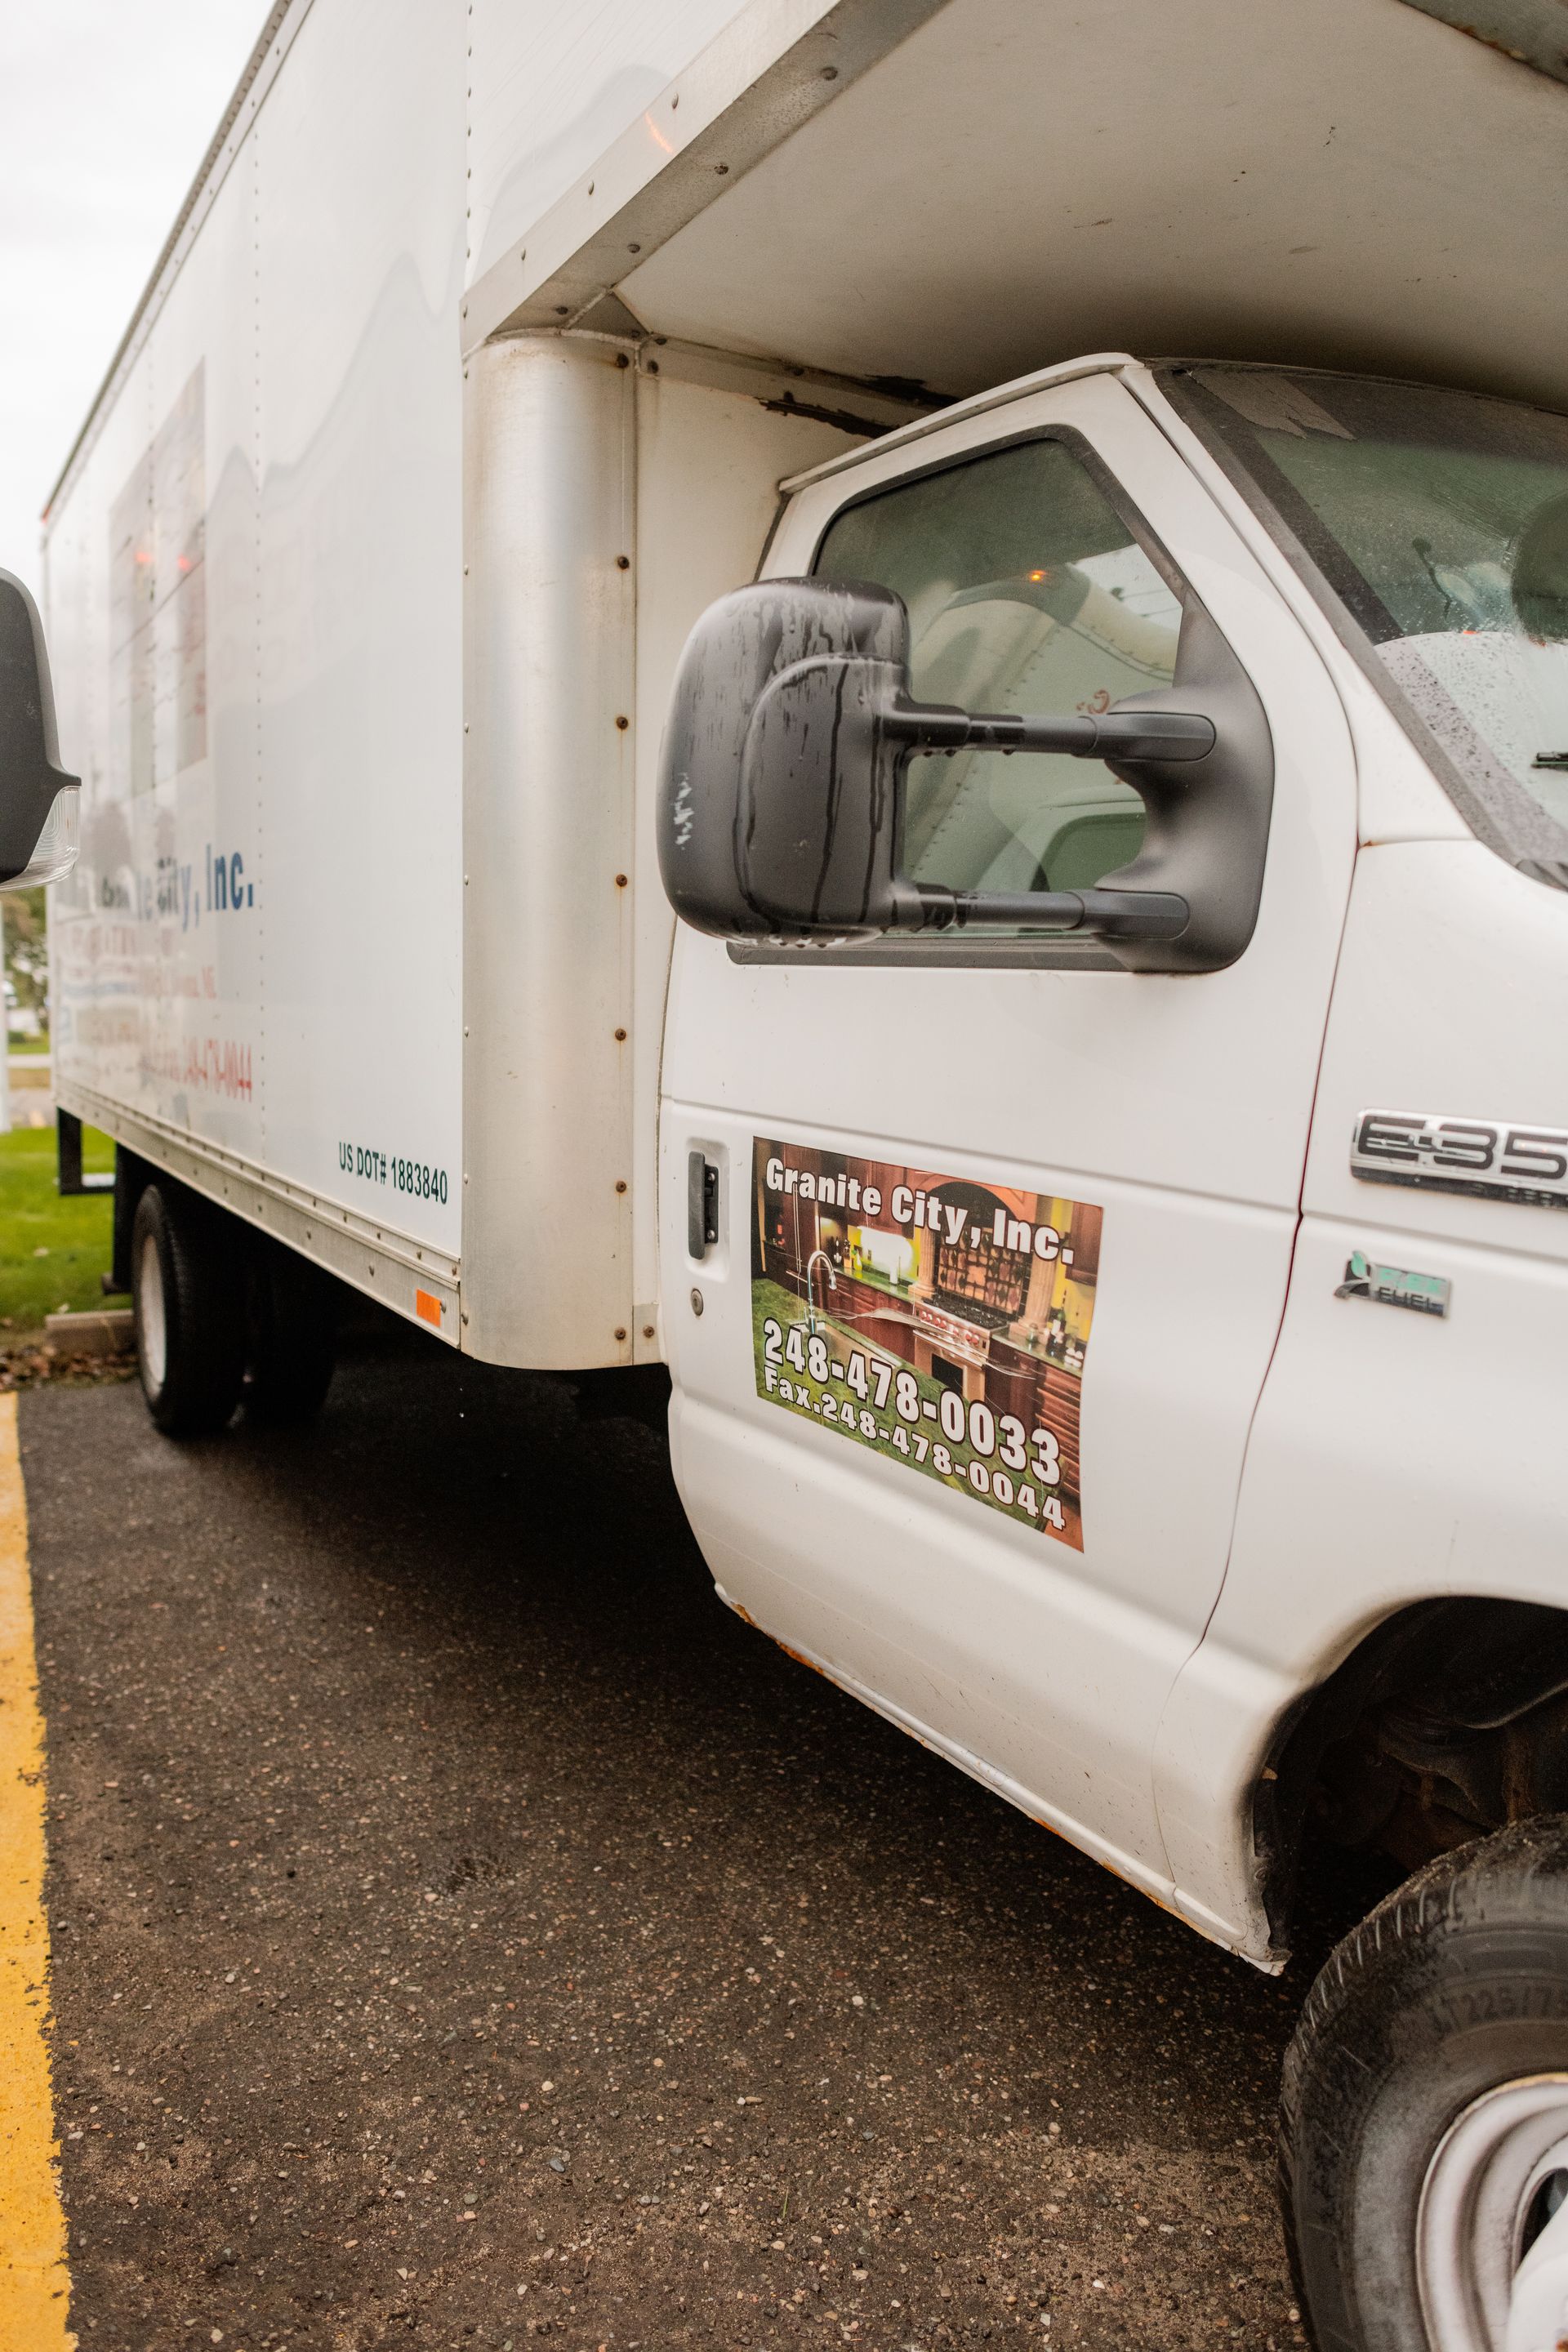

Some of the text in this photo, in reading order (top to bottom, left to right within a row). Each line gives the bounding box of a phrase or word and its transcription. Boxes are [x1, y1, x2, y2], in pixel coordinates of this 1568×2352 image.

[206, 844, 255, 911] Inc.
[339, 1141, 448, 1205] US DOT# 1883840
[765, 1157, 1076, 1265] Granite City, Inc.
[763, 1317, 1062, 1486] 248-478-0033
[764, 1365, 1067, 1532] Fax.248-478-0044
